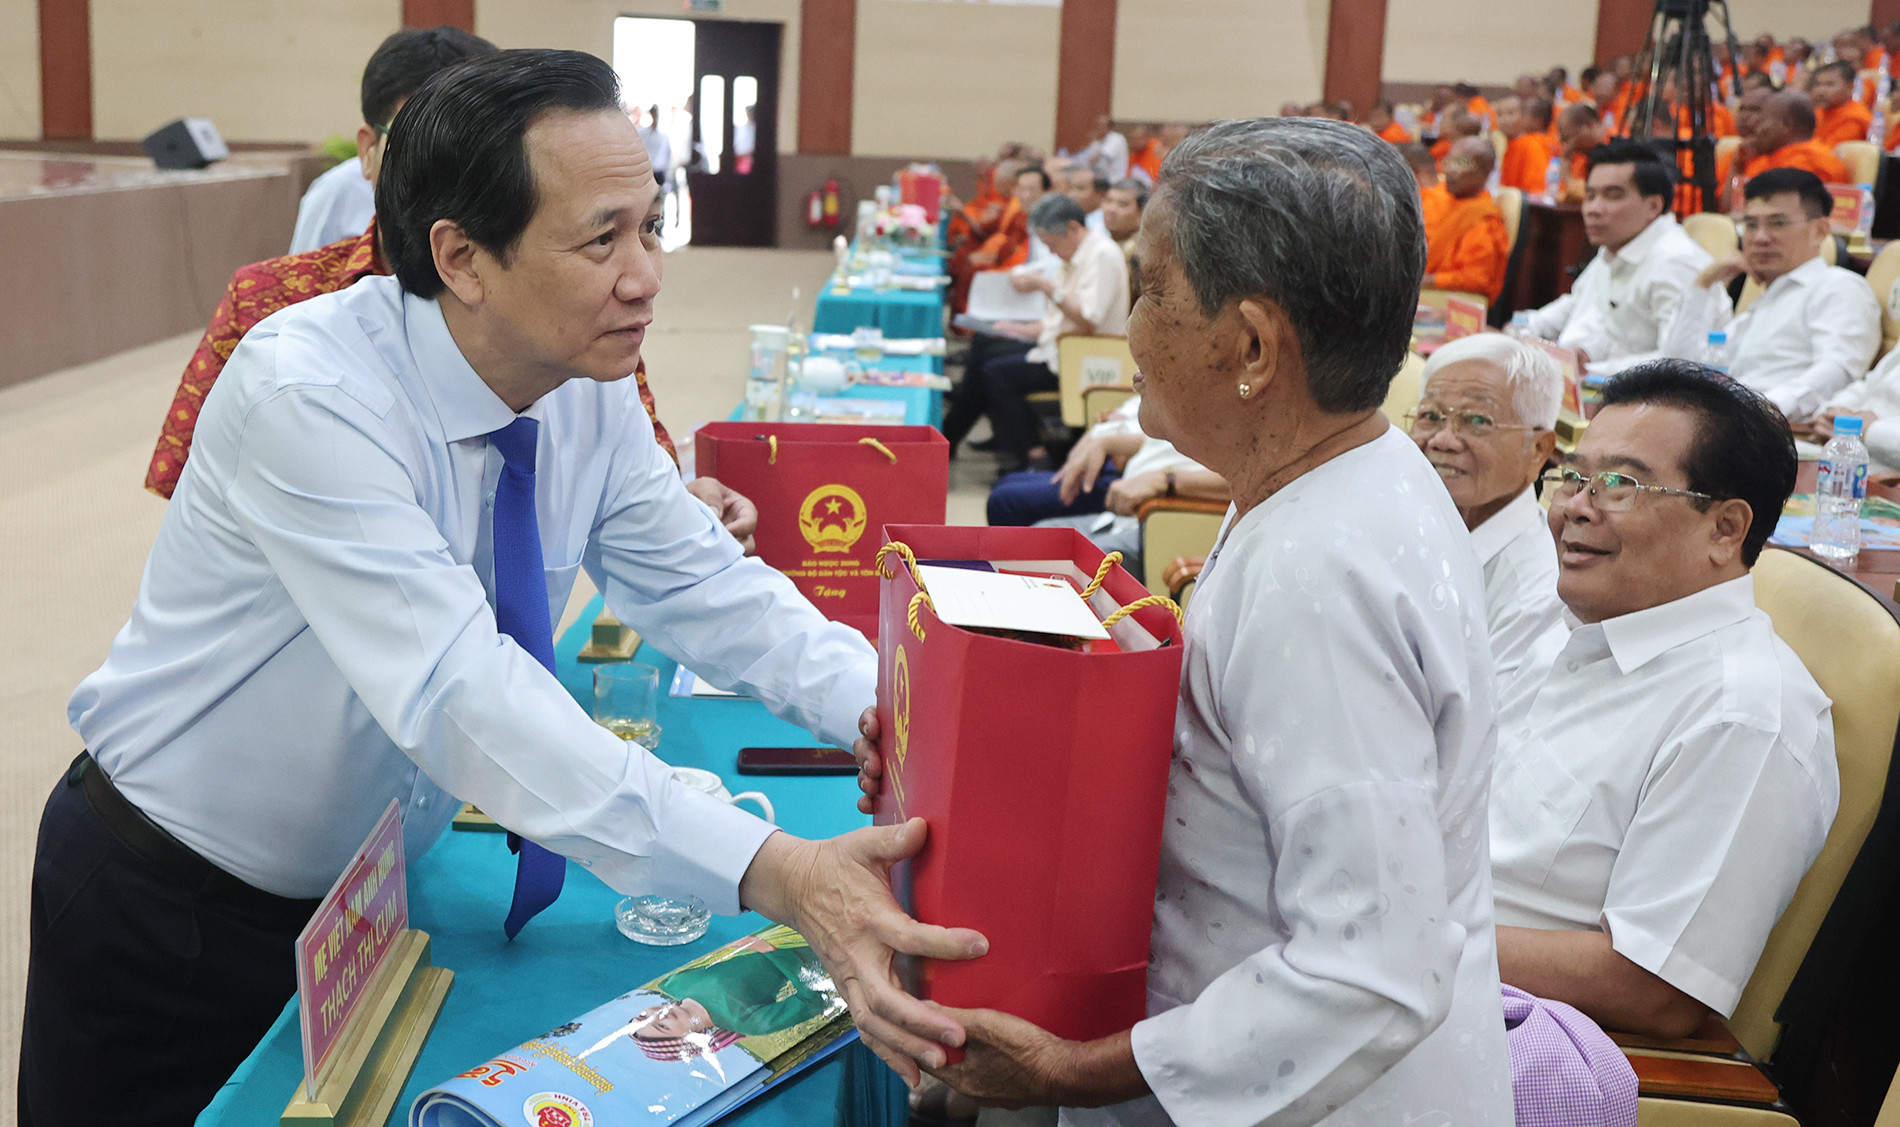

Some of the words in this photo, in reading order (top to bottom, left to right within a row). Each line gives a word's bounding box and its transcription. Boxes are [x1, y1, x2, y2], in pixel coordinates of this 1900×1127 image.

[1087, 369, 1116, 382] VIP
[314, 941, 328, 986] MẸ
[328, 916, 344, 963] VIỆT
[345, 889, 362, 938] NAM
[363, 866, 378, 911] ANH
[378, 840, 395, 887] HÙNG
[320, 956, 357, 1036] THẠCH
[357, 926, 375, 975] THỊ
[376, 890, 397, 945] CỤM
